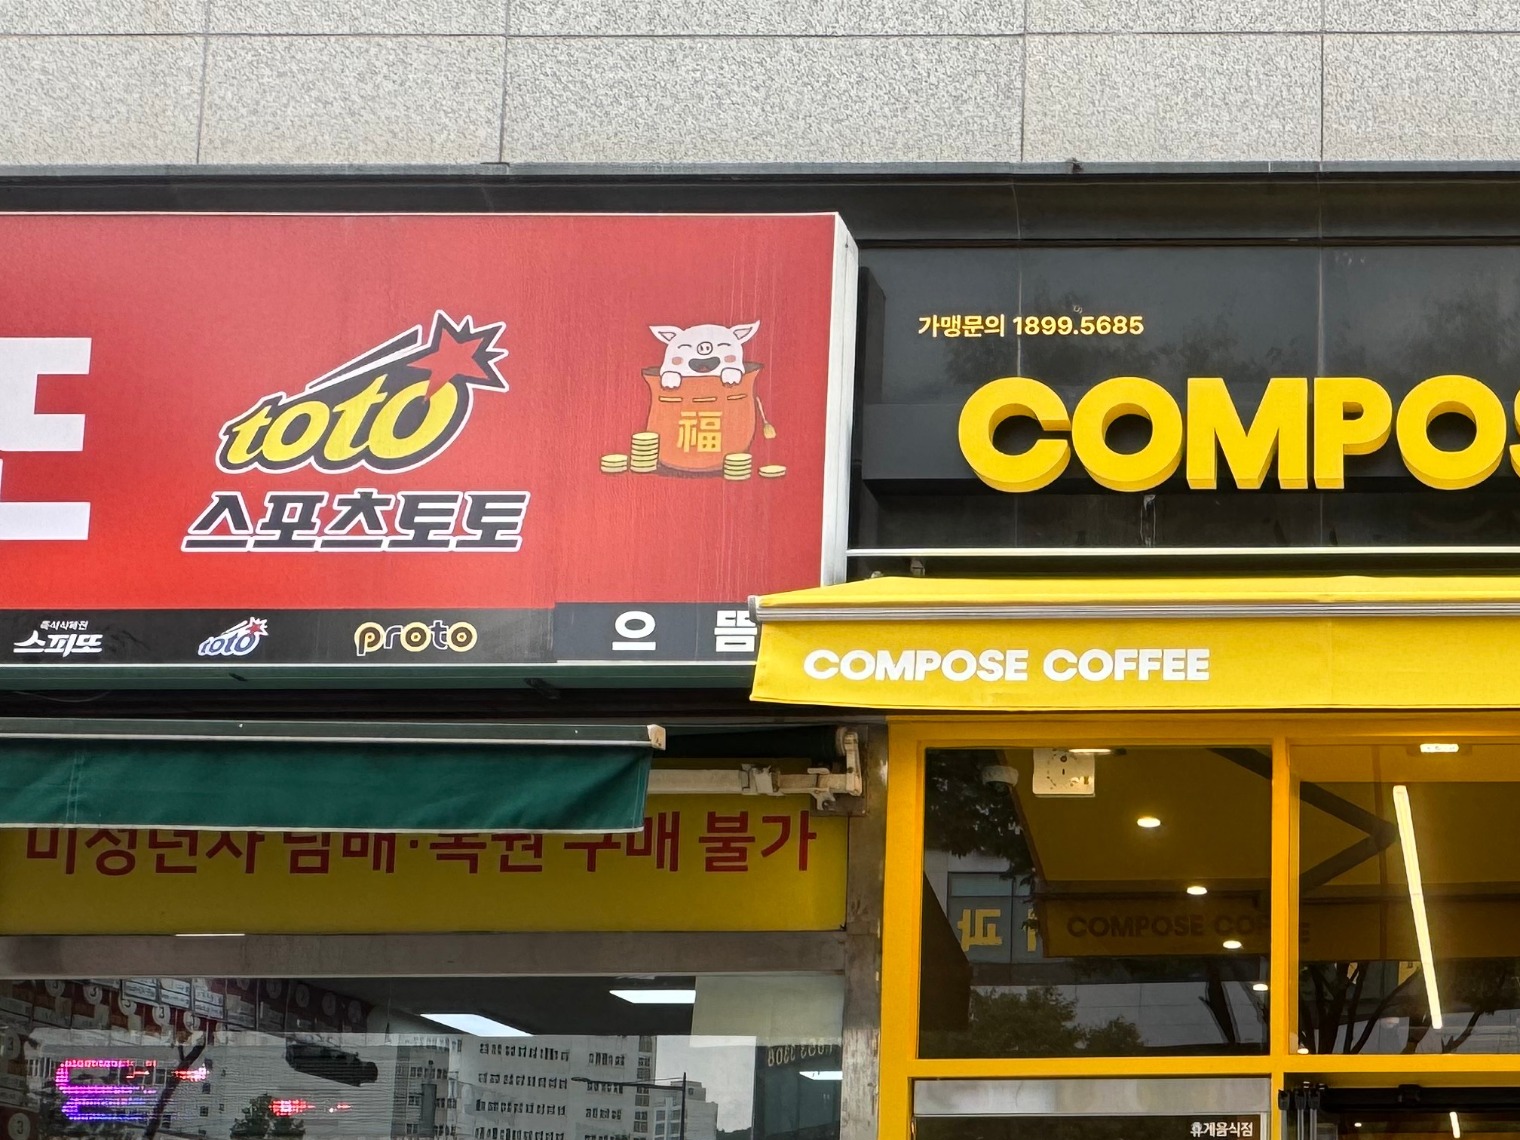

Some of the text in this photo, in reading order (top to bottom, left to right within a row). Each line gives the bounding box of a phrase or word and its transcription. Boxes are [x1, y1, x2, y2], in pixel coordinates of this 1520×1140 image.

[918, 313, 1144, 339] 가맹문의 1899.5685
[676, 410, 723, 454] 福
[181, 489, 531, 553] 스포츠토토
[13, 630, 104, 658] 스피또
[353, 621, 478, 659] proto
[803, 648, 1210, 682] COMPOSE COFFEE
[699, 810, 818, 873] 불가
[1190, 1121, 1254, 1138] 휴게음식점
